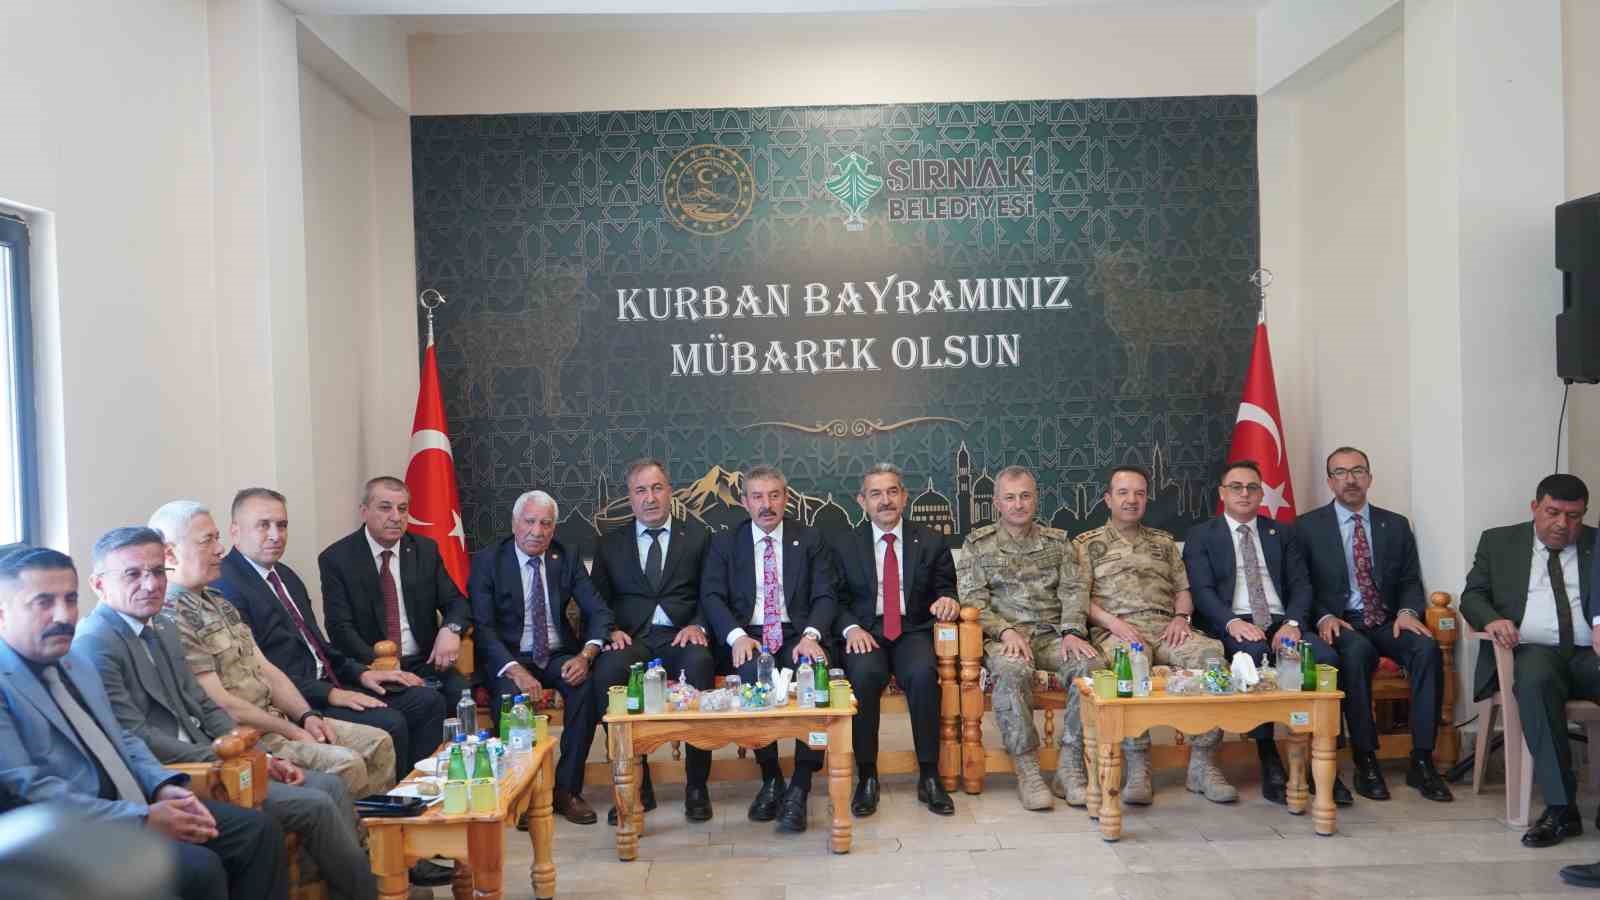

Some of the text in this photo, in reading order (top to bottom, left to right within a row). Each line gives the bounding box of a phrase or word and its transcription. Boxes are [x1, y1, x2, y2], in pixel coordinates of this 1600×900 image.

[616, 273, 1073, 321] KURBAN BAYRAMINIZ
[670, 333, 1022, 377] MÜBAREK OLSUN
